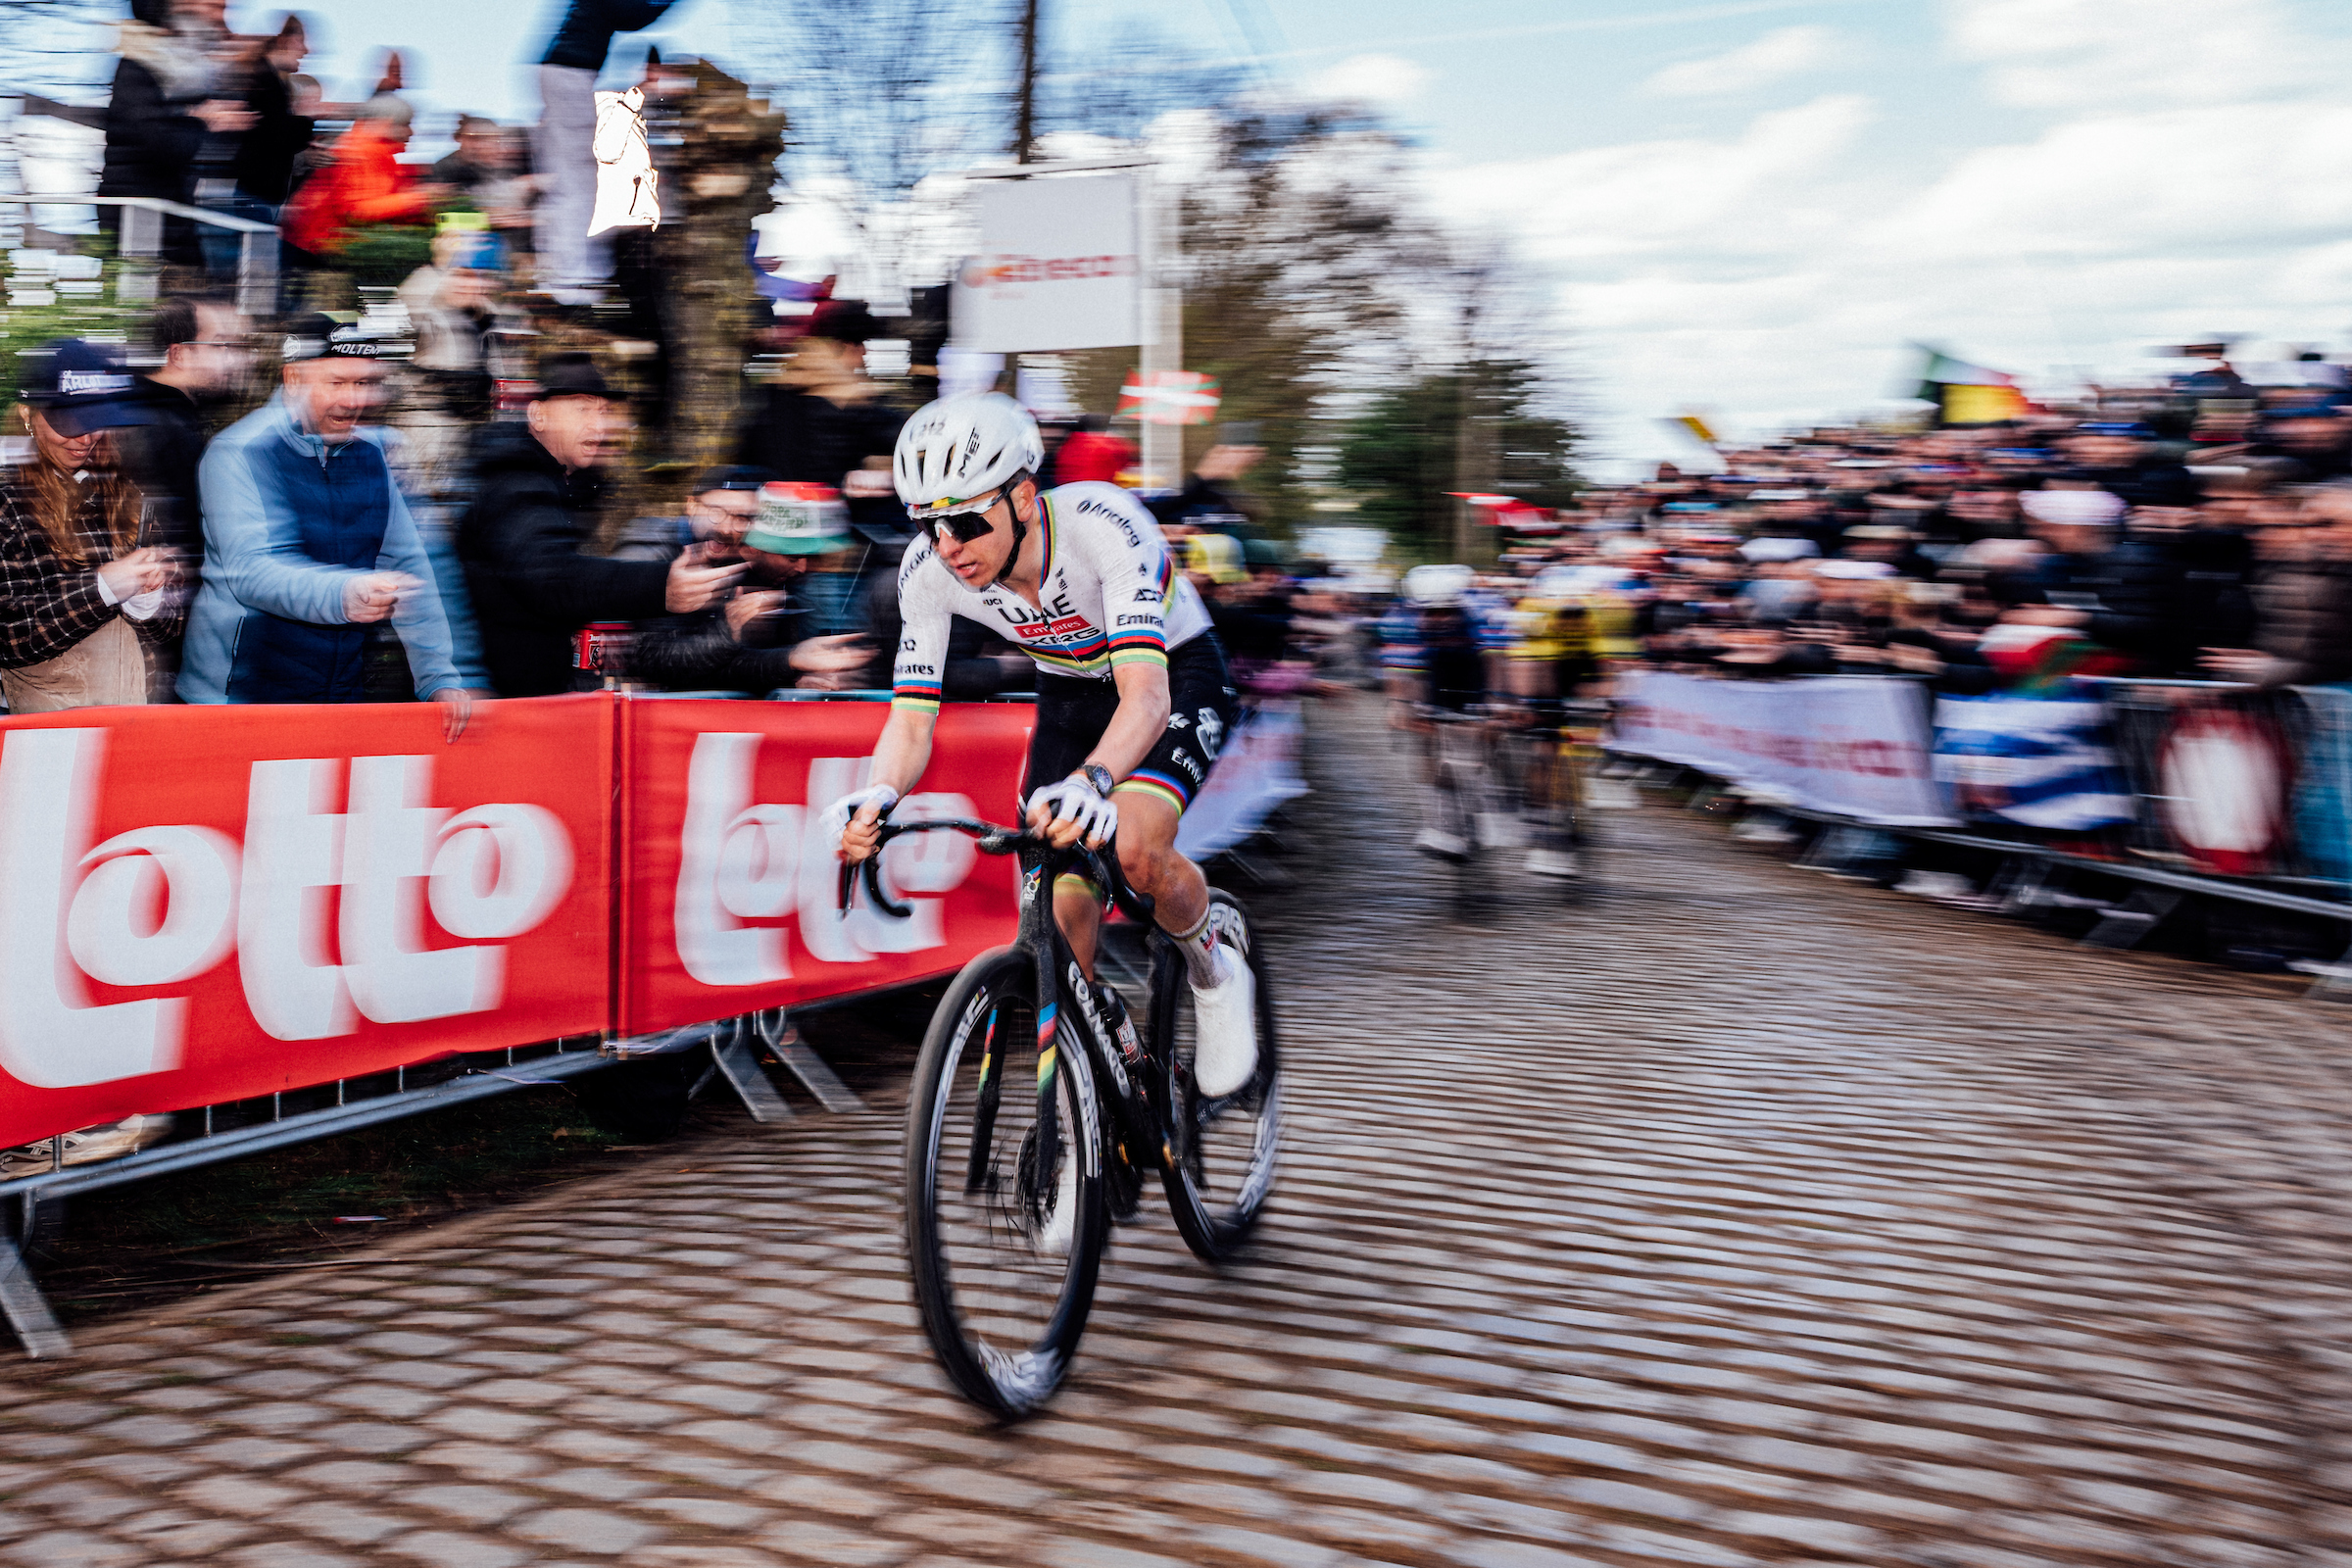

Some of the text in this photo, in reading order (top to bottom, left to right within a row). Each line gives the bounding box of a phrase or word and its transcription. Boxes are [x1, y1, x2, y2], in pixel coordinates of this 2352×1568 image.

[1088, 502, 1141, 548] Analog
[985, 598, 1003, 607] UCI
[998, 593, 1076, 624] UAE
[1022, 620, 1081, 636] Emates
[1067, 960, 1132, 1100] COLNAGO
